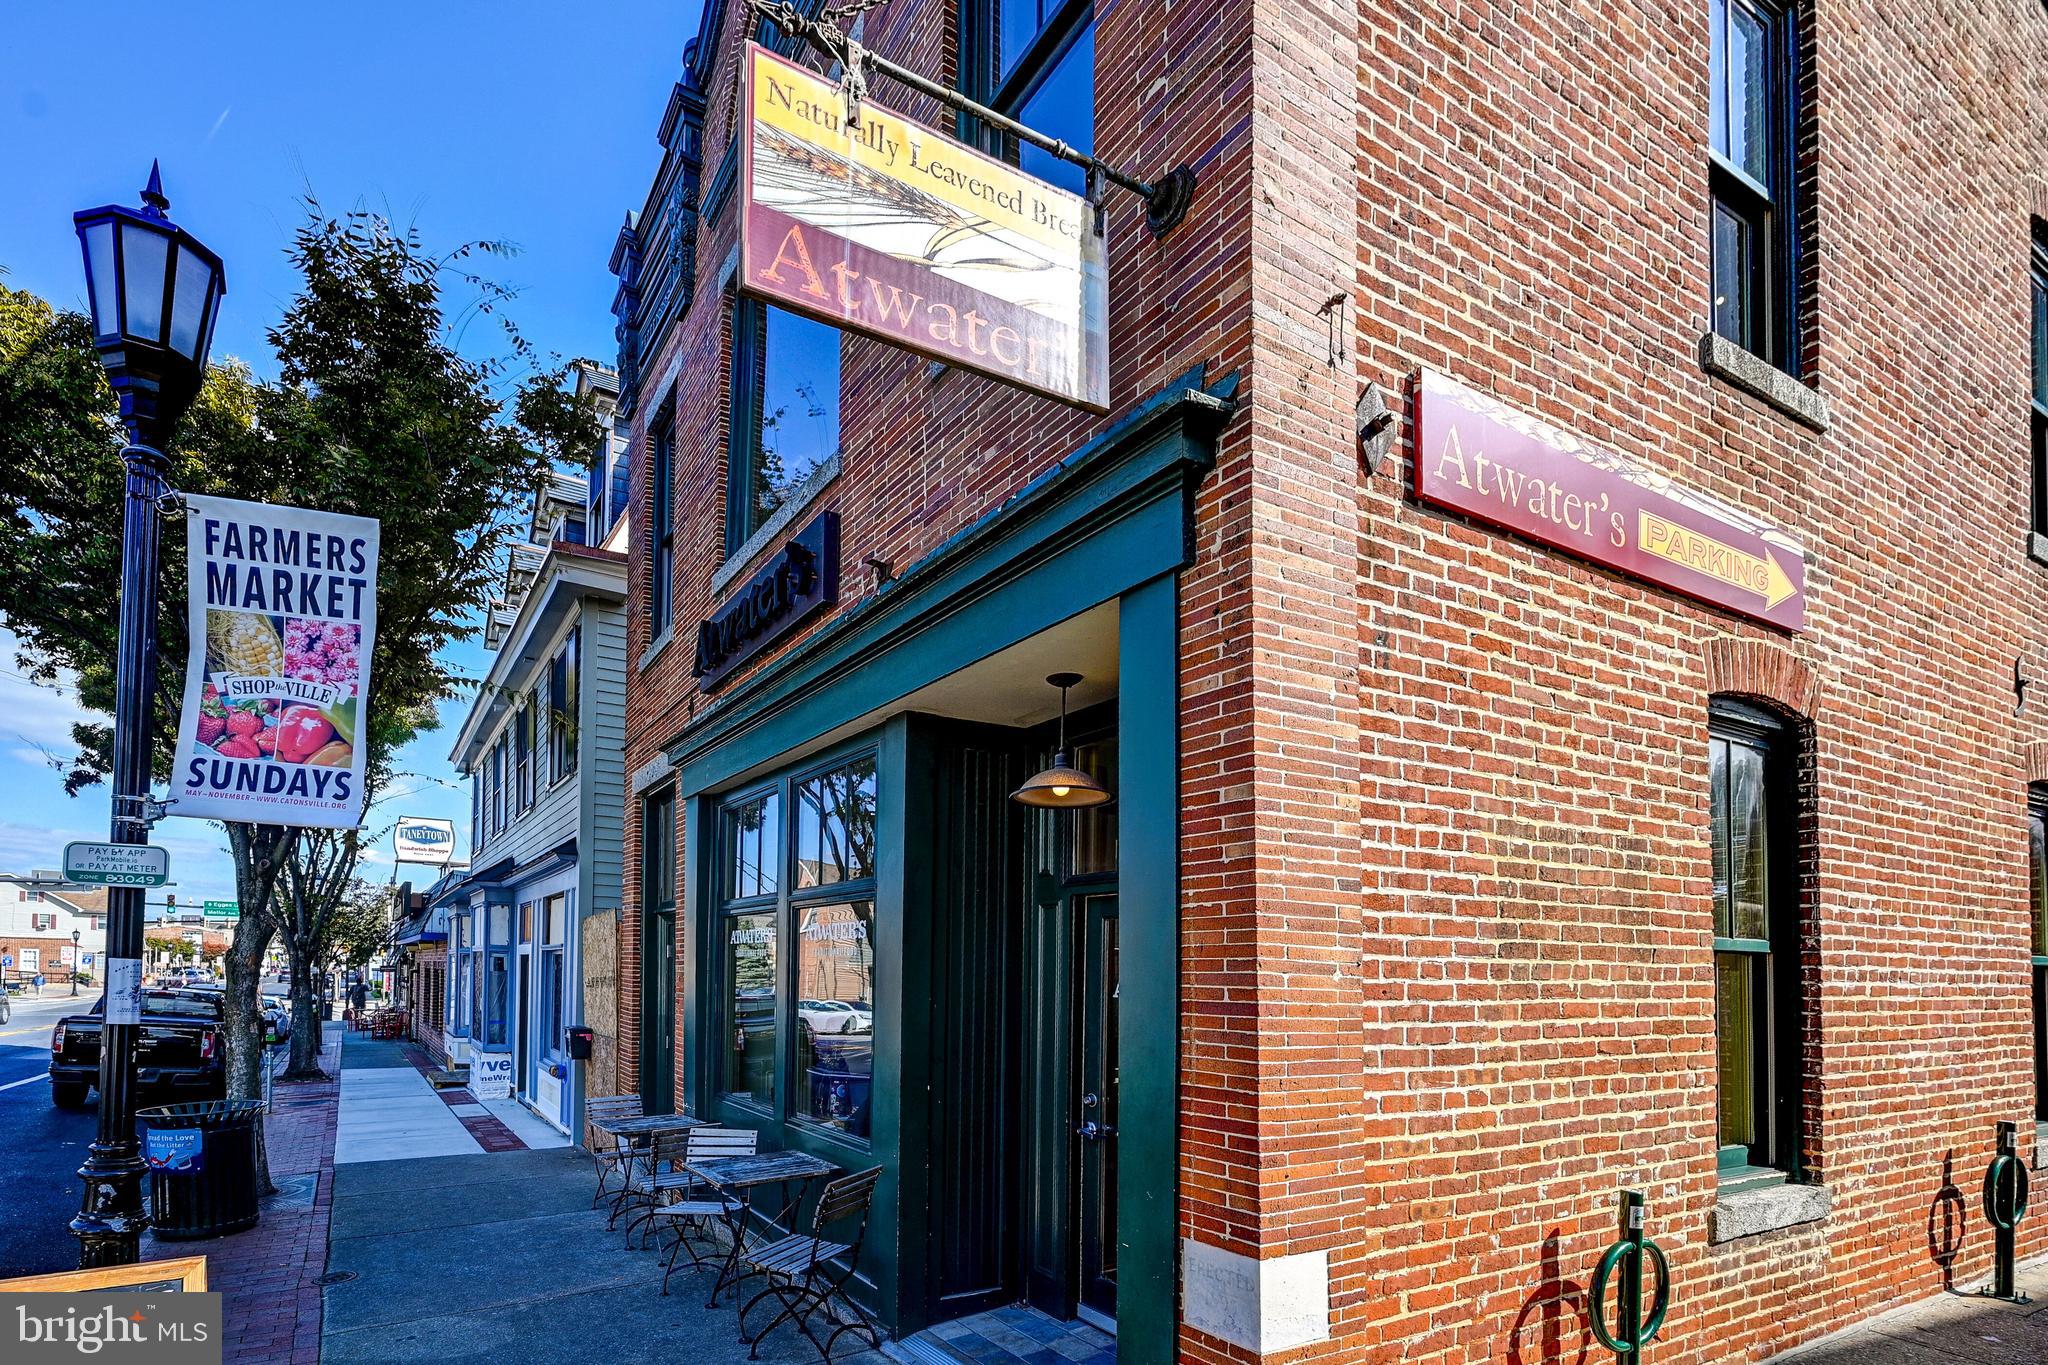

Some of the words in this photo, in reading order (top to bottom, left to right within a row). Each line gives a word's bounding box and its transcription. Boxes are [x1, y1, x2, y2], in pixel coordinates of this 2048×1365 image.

[766, 76, 899, 167] Naturally
[909, 141, 1023, 216] Leavened
[1433, 423, 1627, 549] Atwater's
[1646, 518, 1770, 592] PARKING
[205, 519, 367, 575] FARMERS
[206, 560, 367, 620] MARKET
[232, 680, 275, 695] SHOP
[274, 684, 287, 692] the
[285, 681, 332, 704] VILLE
[186, 757, 353, 801] SUNDAYS
[401, 829, 450, 843] TANEYTOWN
[88, 847, 109, 855] PAY
[111, 847, 123, 856] BY
[127, 849, 147, 857] APP
[96, 855, 138, 863] ParkMobile.io
[88, 862, 109, 870] PAY
[126, 864, 157, 873] METER
[105, 874, 155, 884] 83049
